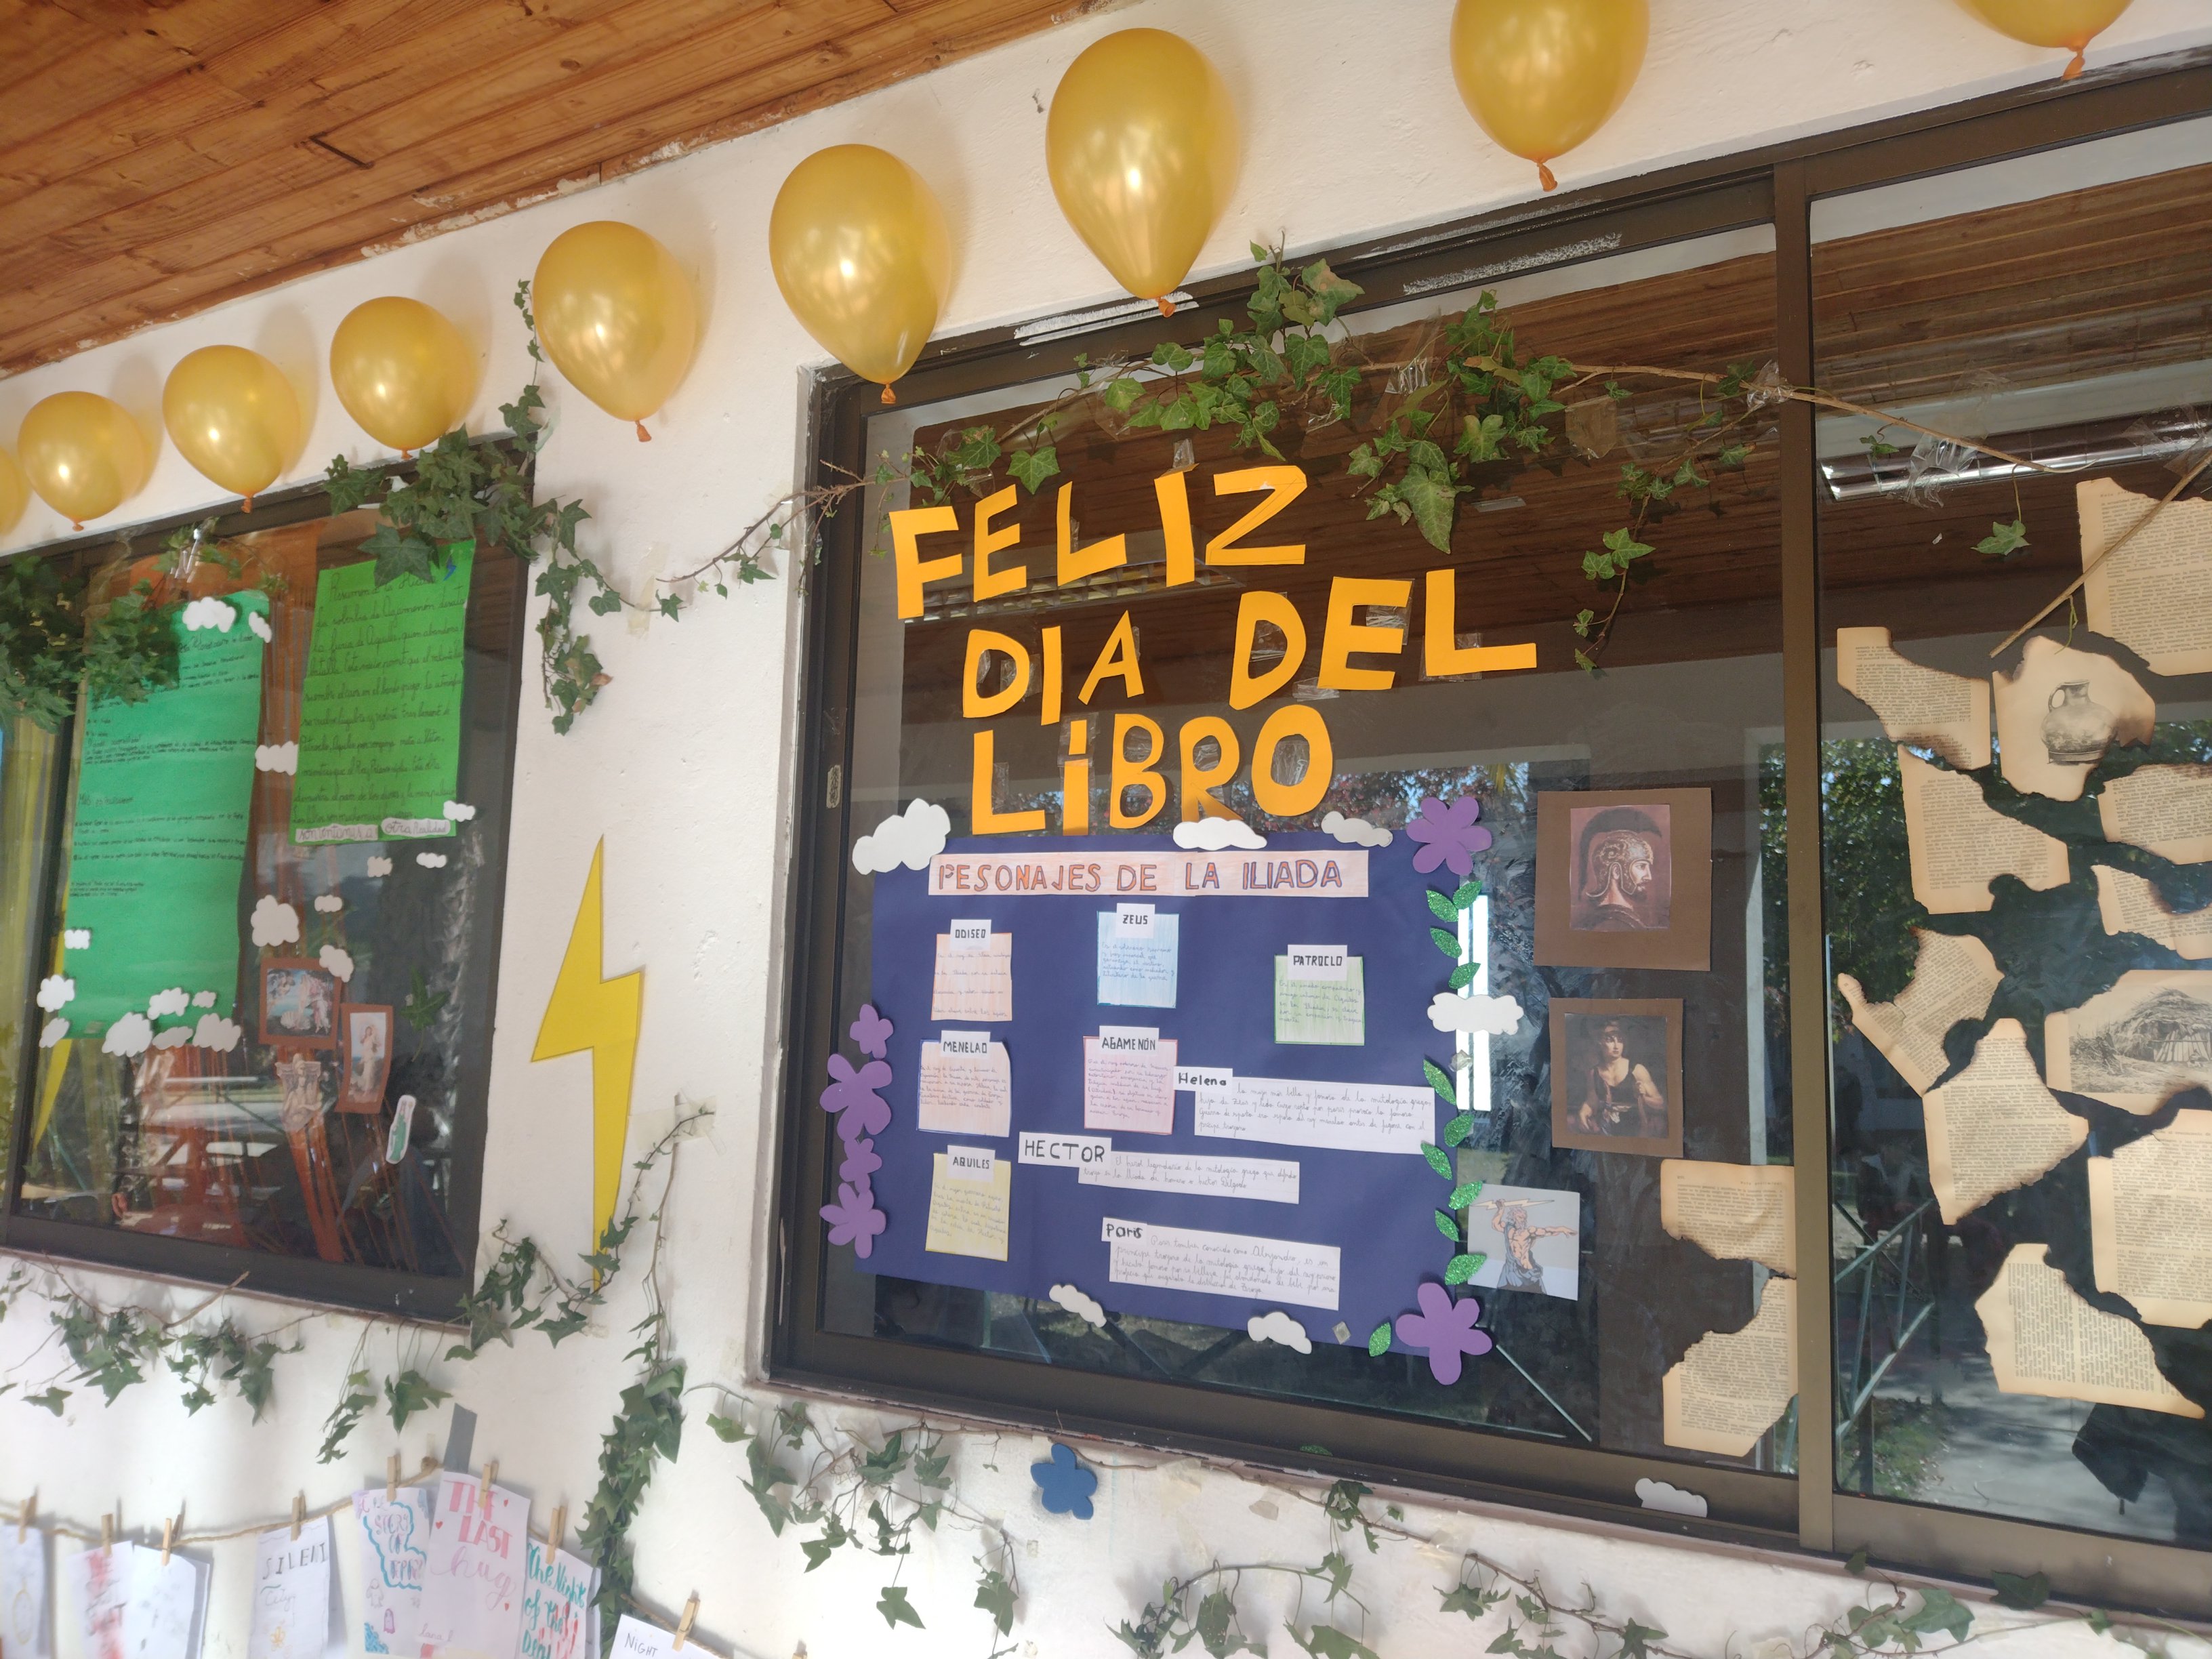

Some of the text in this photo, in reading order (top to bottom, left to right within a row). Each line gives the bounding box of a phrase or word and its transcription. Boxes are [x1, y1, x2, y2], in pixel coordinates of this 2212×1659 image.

[888, 465, 1307, 619] FELIZ
[962, 569, 1537, 726] DIA DEL
[939, 859, 1343, 891] PESONAJES DE LA ILIADA
[1122, 914, 1148, 924] ZEUS
[955, 929, 986, 939] ODISEO
[1293, 956, 1343, 966] PATROCLO
[943, 1041, 987, 1054] MENELAO
[1179, 1072, 1227, 1086] Helena
[1024, 1139, 1105, 1163] HECTOR
[953, 1156, 990, 1169] AQUILES
[1106, 1223, 1143, 1239] Paris
[458, 1515, 512, 1559] LAST
[430, 1546, 516, 1611] hug
